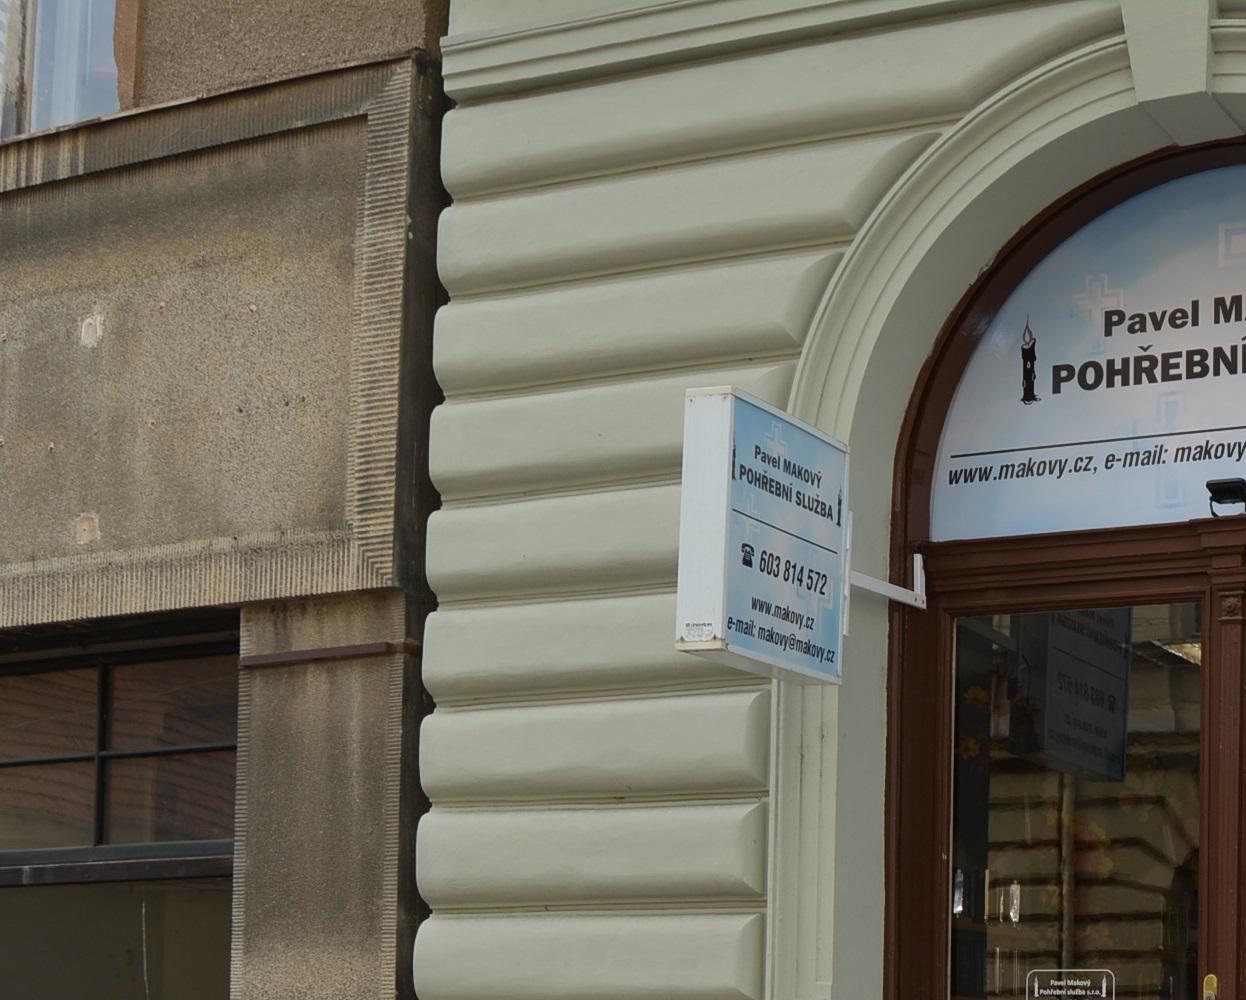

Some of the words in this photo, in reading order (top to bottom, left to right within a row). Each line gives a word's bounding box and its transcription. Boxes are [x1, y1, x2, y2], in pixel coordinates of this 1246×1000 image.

[1103, 298, 1200, 338] Pavel
[754, 445, 781, 469] Pavel
[783, 460, 823, 489] MAKOVÝ
[947, 453, 1099, 486] www.makovy.cz,
[1104, 446, 1169, 471] e-mail:
[739, 464, 793, 504] POHŘEBNÍ
[795, 491, 834, 521] SLUŽBA
[759, 550, 781, 578] 603
[783, 557, 804, 586] 814
[806, 566, 828, 595] 572
[751, 596, 815, 630] www.makovy.cz
[727, 616, 757, 639] e-mail:
[757, 627, 835, 663] makovy@makovy.cz
[1067, 979, 1091, 987] Makový
